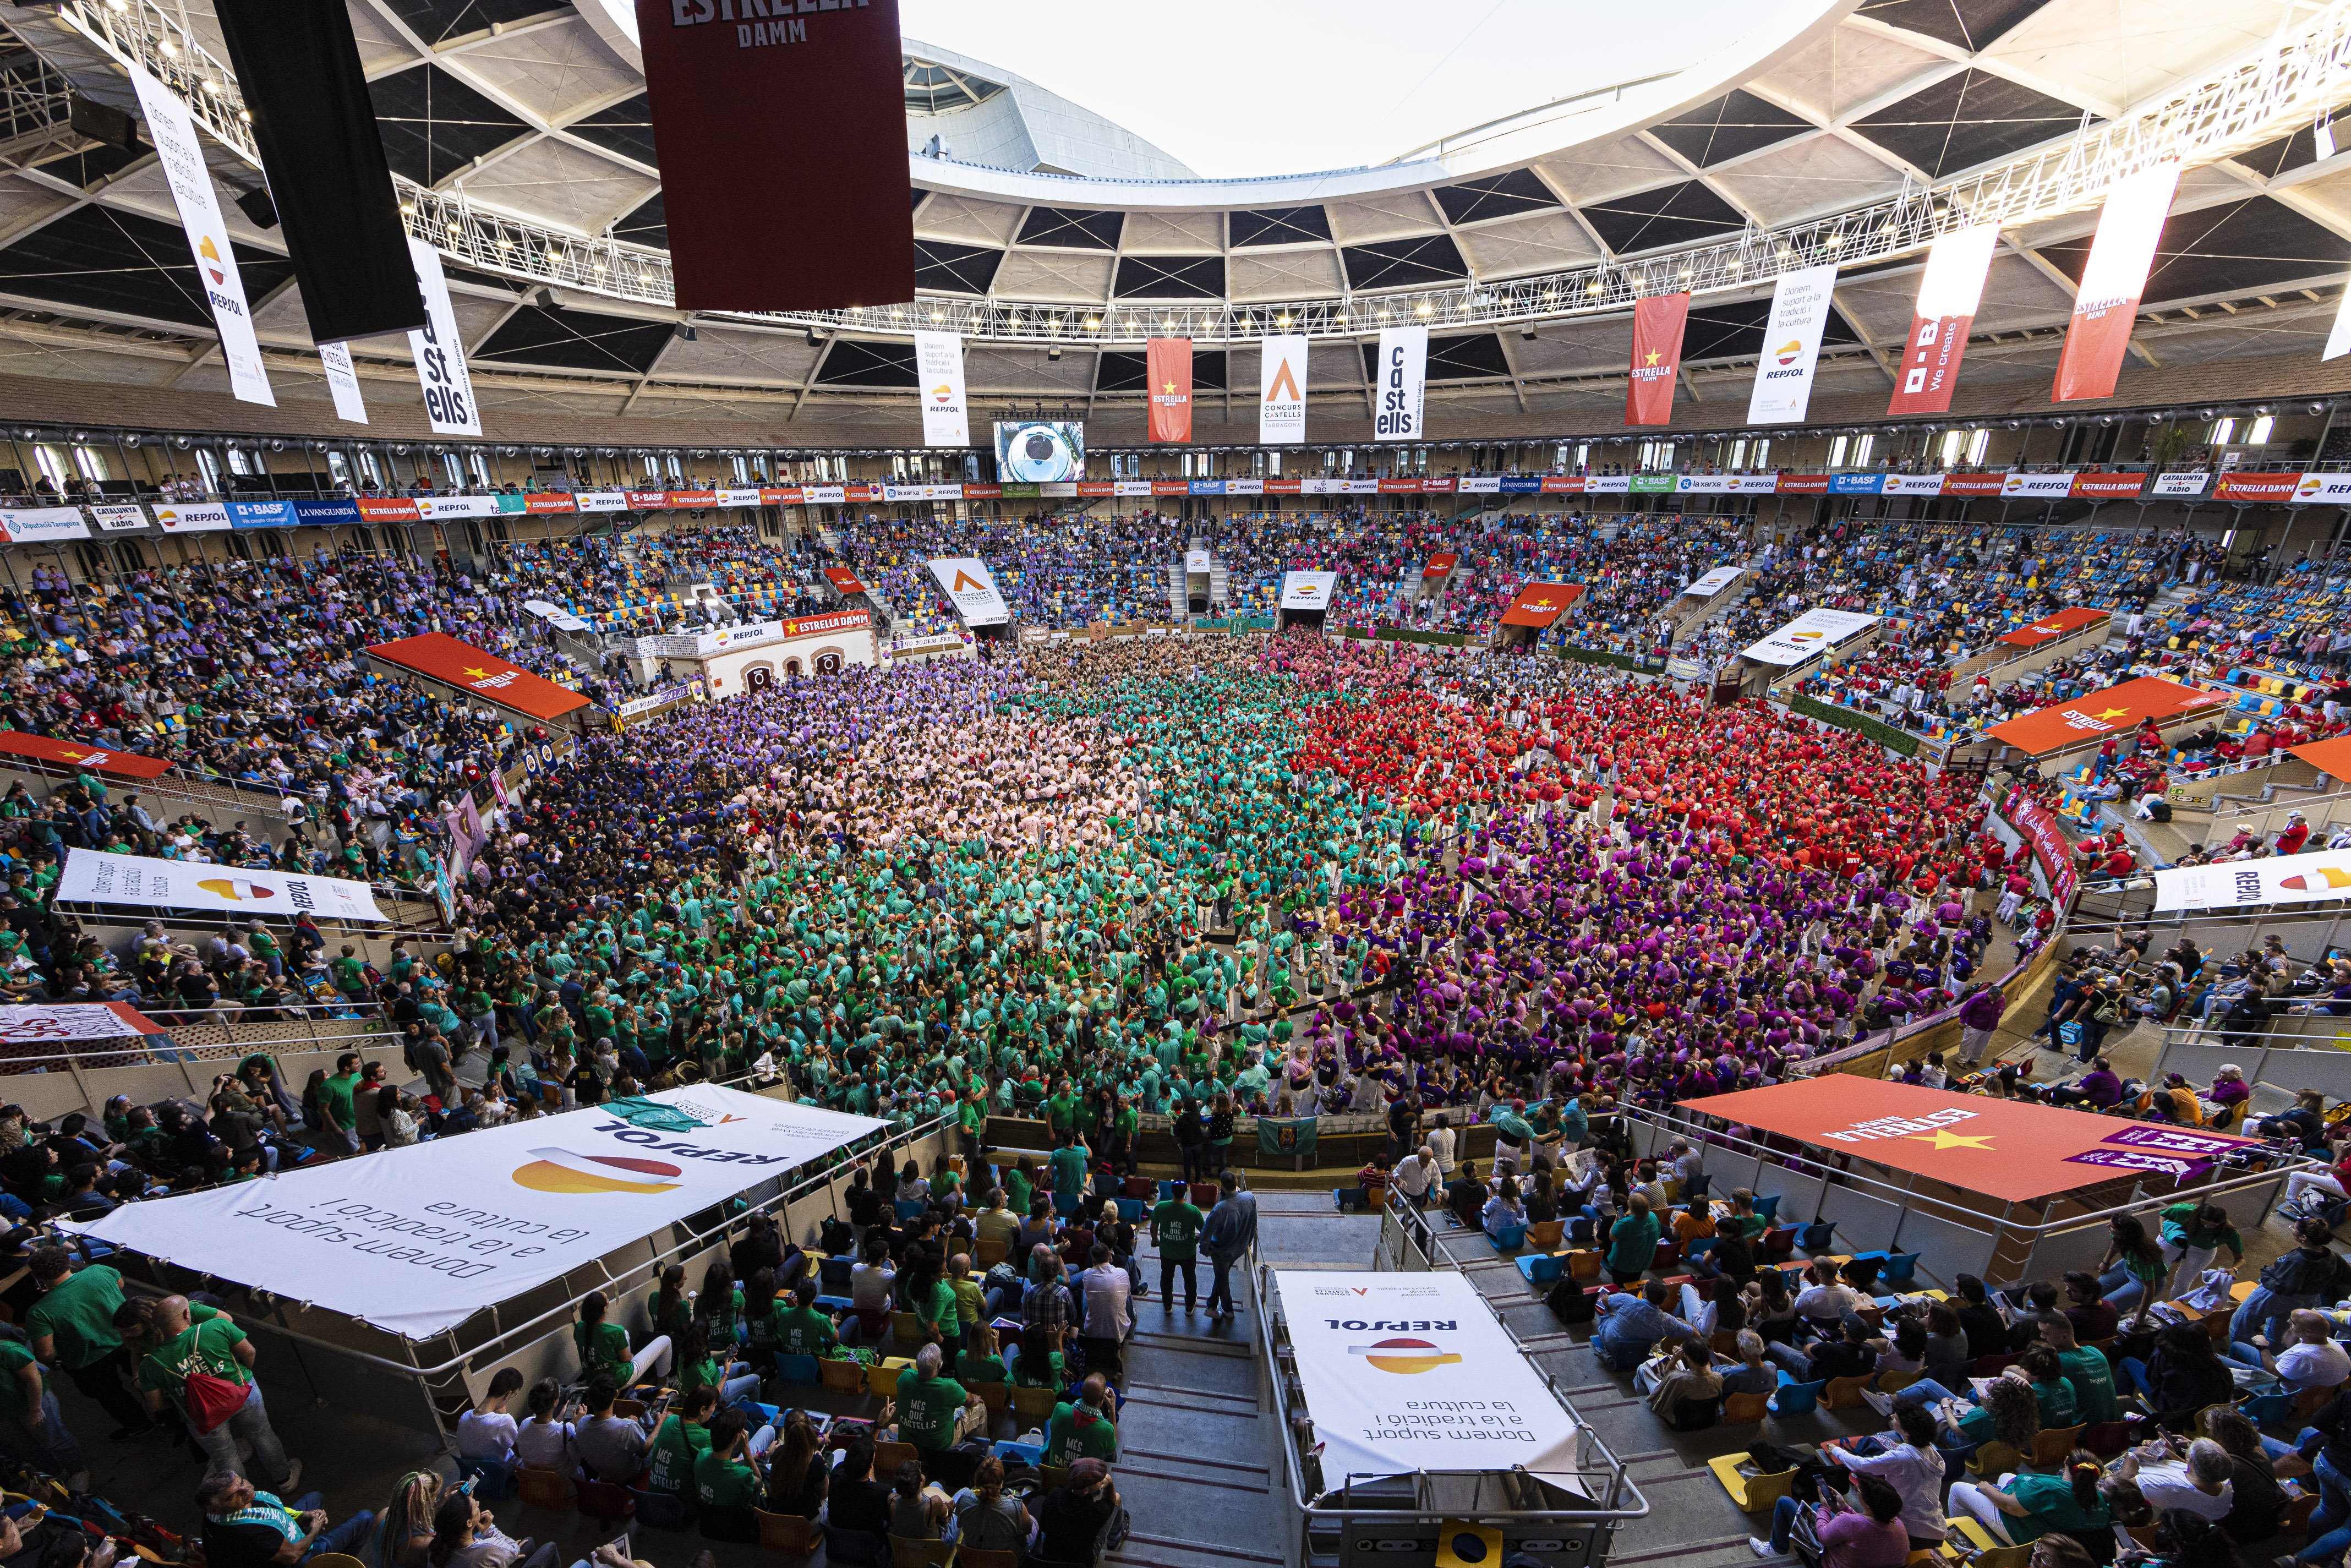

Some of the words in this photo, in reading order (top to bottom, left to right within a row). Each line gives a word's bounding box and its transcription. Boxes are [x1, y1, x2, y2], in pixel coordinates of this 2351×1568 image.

[737, 19, 807, 48] DAMM
[1784, 285, 1811, 296] Donem
[209, 291, 242, 316] REPSOL
[1783, 296, 1806, 307] suport
[1813, 292, 1820, 302] la
[1780, 306, 1807, 318] tradició
[1808, 304, 1811, 313] i
[2086, 310, 2107, 321] DAMM
[1778, 320, 1784, 328] la
[1786, 316, 1812, 327] cultura
[453, 338, 463, 367] Catalunya
[1929, 369, 1944, 391] We
[1939, 321, 1958, 365] create
[1632, 366, 1671, 378] ESTRELLA
[1766, 368, 1804, 379] REPSOL
[1851, 476, 1876, 484] BASF
[255, 504, 283, 515] BASF
[185, 512, 227, 522] REPSOL
[111, 520, 134, 528] RÀDIO
[800, 617, 839, 632] ESTRELLA
[840, 615, 868, 626] DAMM
[734, 629, 764, 640] REPSOL
[916, 637, 937, 646] PODEM
[1768, 641, 1810, 652] REPSOL
[469, 671, 520, 688] ESTRELLA
[640, 698, 659, 708] PODEM
[660, 689, 686, 702] SOMIAR
[2060, 709, 2114, 731] ESTRELLA
[2235, 872, 2262, 902] REPSOL
[286, 881, 315, 909] REPSOL
[673, 1101, 714, 1118] CASTELLS
[1819, 1107, 1981, 1142] ESTRELLA
[1848, 1116, 1907, 1128] DAMM
[592, 1120, 790, 1165] REPSOL
[309, 1198, 348, 1209] i
[237, 1204, 363, 1243] suport
[424, 1201, 549, 1234] cultura
[326, 1203, 472, 1246] tradició
[548, 1229, 591, 1244] la
[1163, 1232, 1189, 1241] CASTELLS
[468, 1239, 513, 1256] la
[511, 1245, 545, 1258] a
[353, 1239, 497, 1279] Donem
[1324, 1319, 1458, 1331] REPSOL
[790, 1328, 802, 1337] MÉS
[910, 1400, 926, 1411] MÉS
[1406, 1401, 1486, 1411] cultura
[1494, 1401, 1516, 1412] la
[909, 1410, 923, 1421] QUE
[1376, 1415, 1380, 1425] i
[1388, 1413, 1477, 1425] tradició
[1485, 1416, 1505, 1426] la
[1507, 1416, 1524, 1424] a
[899, 1415, 936, 1430] CASTELLS
[1363, 1429, 1441, 1441] suport
[1448, 1429, 1536, 1442] Donem
[1065, 1437, 1082, 1452] MÉS
[657, 1449, 672, 1464] MÉS
[655, 1463, 669, 1477] QUE
[700, 1482, 714, 1498] MÉS
